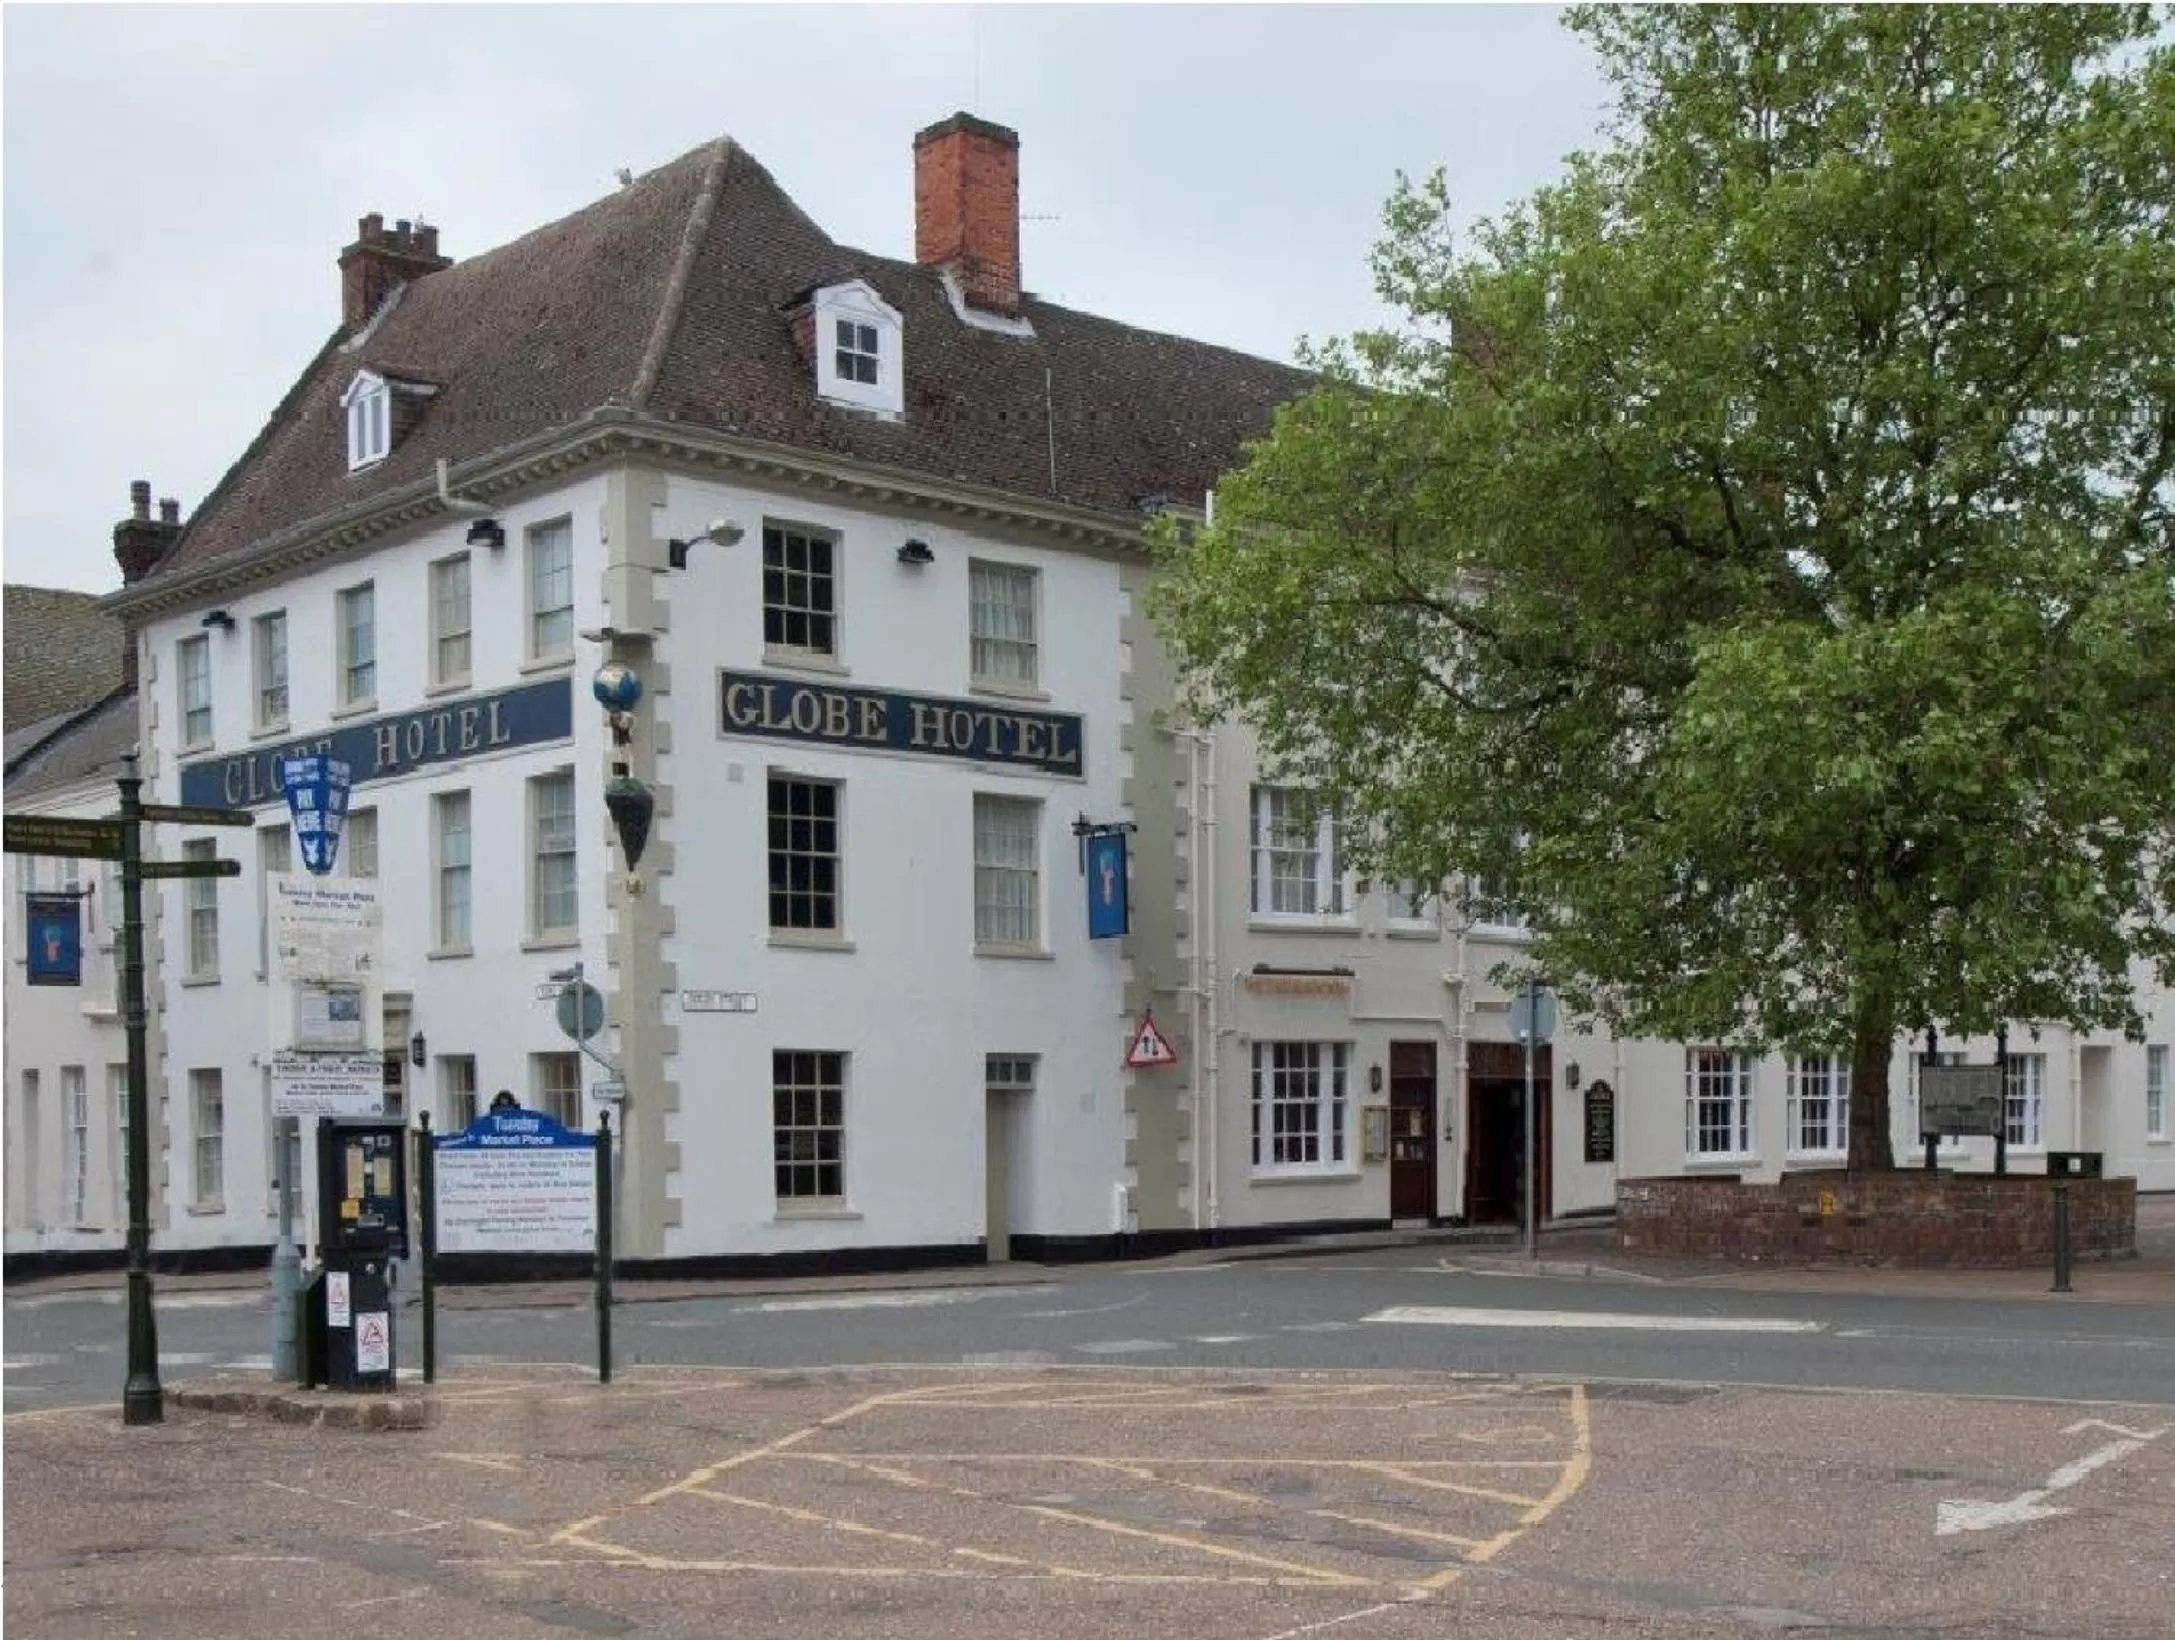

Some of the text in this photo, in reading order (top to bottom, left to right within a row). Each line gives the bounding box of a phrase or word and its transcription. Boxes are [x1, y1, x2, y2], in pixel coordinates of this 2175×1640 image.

[225, 699, 511, 805] GLO HOTEL
[726, 683, 1077, 763] GLOBE HOTEL
